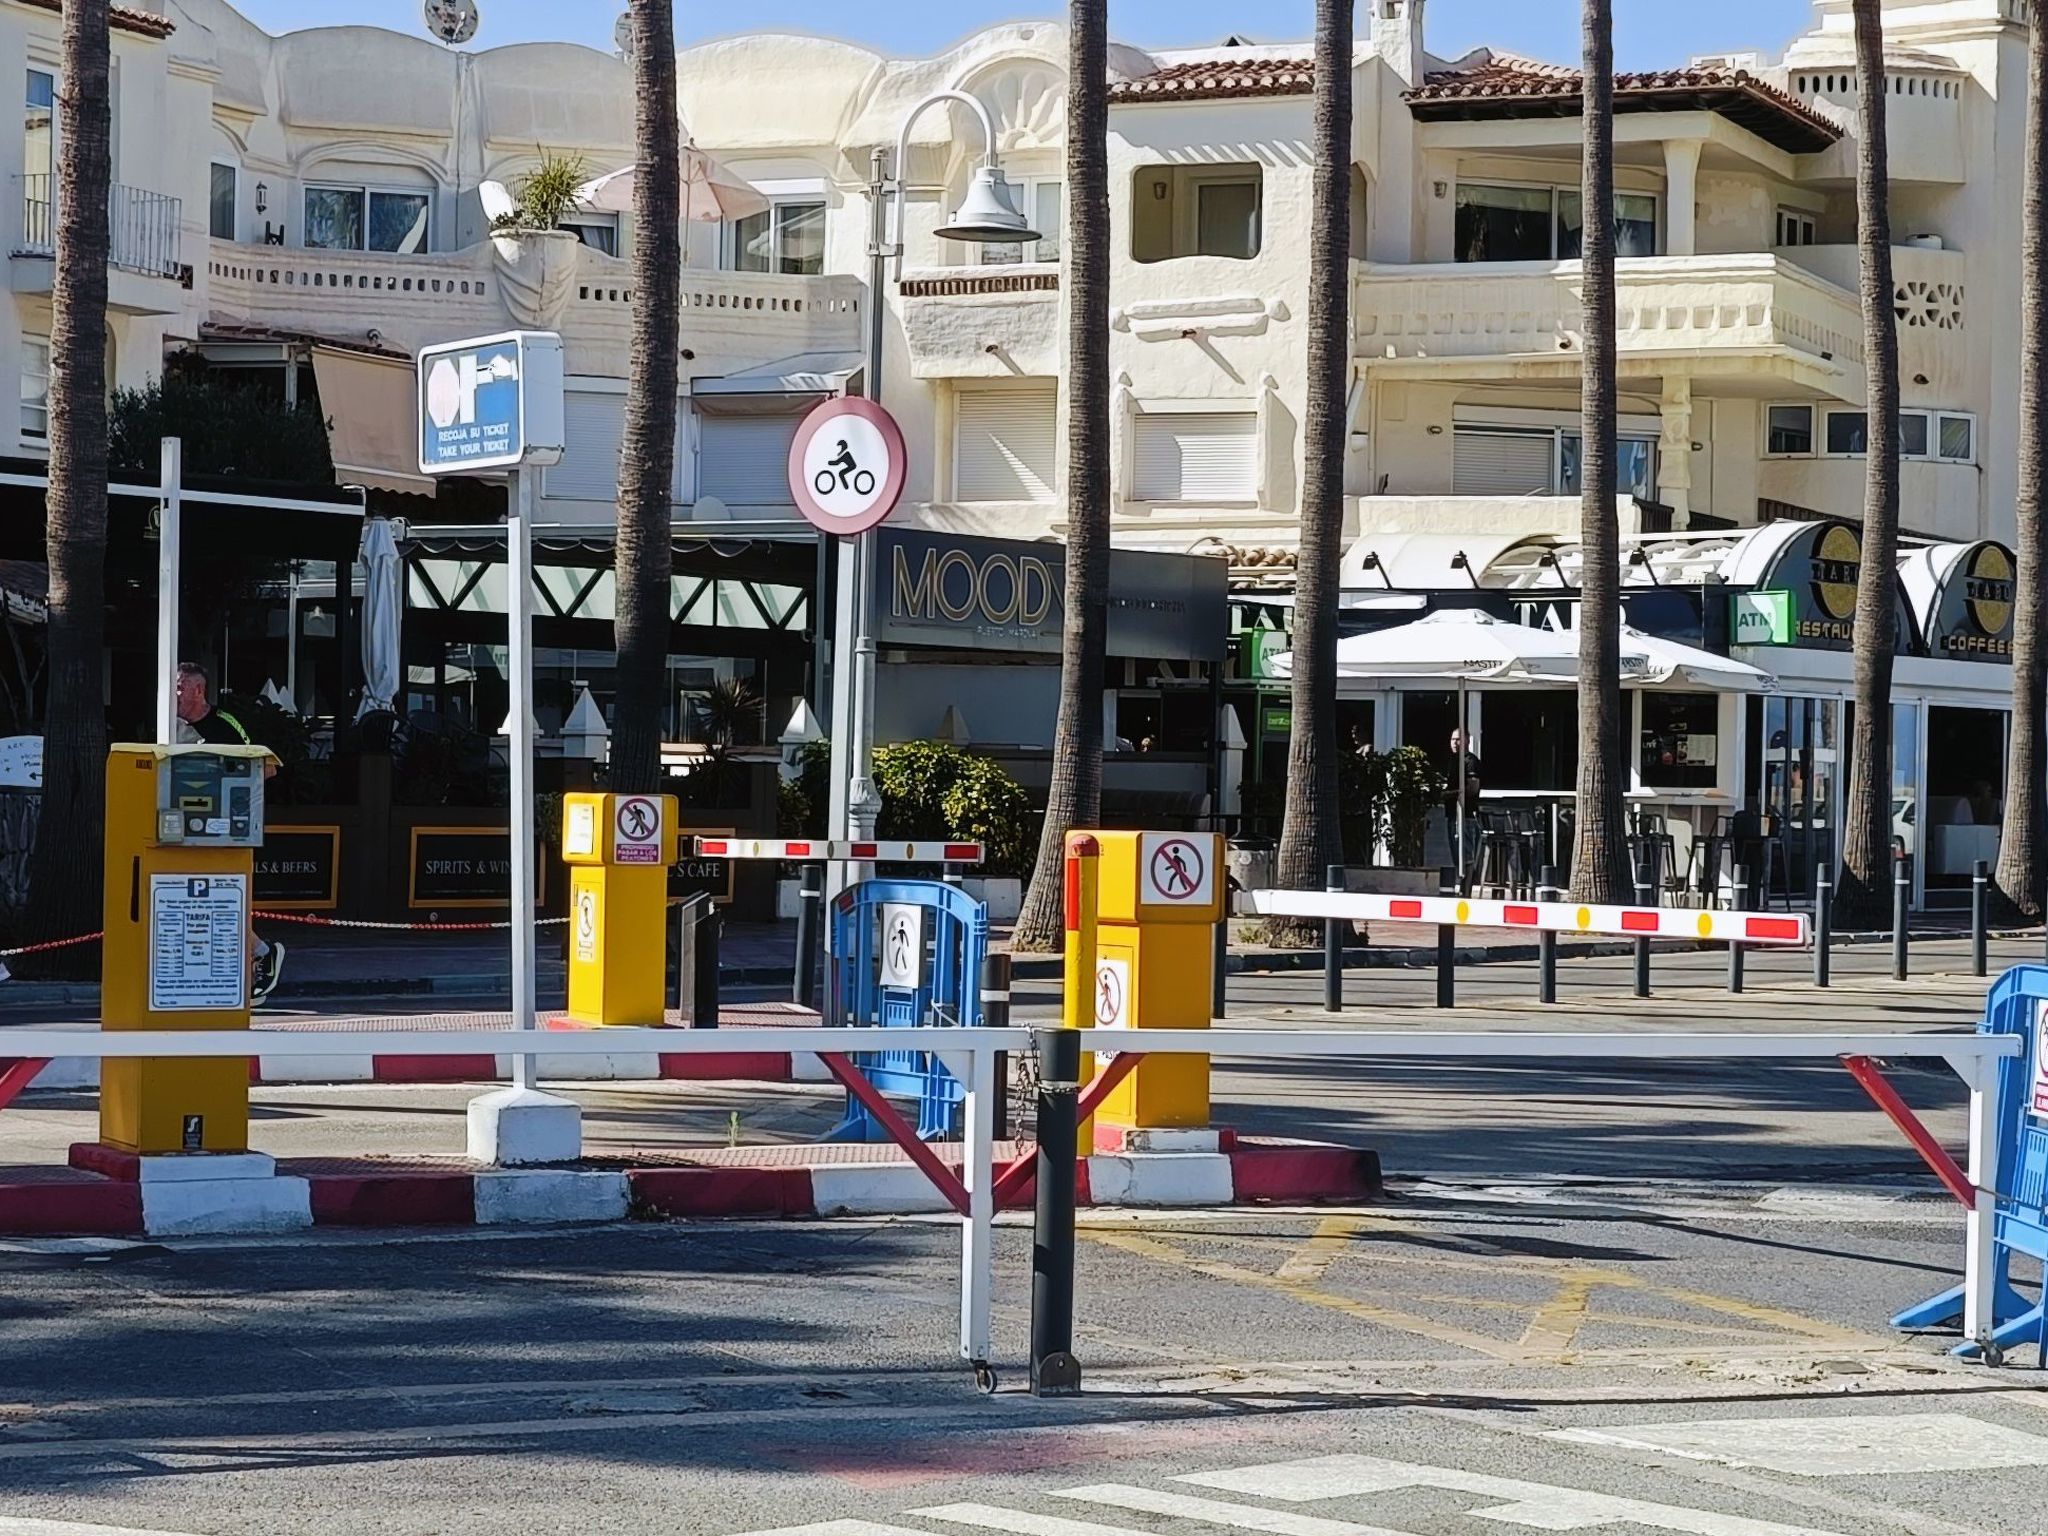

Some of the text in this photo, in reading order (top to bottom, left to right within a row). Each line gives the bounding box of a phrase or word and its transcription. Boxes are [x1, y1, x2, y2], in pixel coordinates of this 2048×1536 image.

[438, 422, 509, 441] RECOJA SU TICKET
[438, 439, 509, 457] TAKE YOUR TICKET
[270, 862, 279, 873] &
[282, 862, 317, 873] BEERS
[425, 860, 471, 874] SPIRITS
[476, 861, 486, 874] &
[687, 862, 720, 877] CAFE
[194, 880, 206, 896] P
